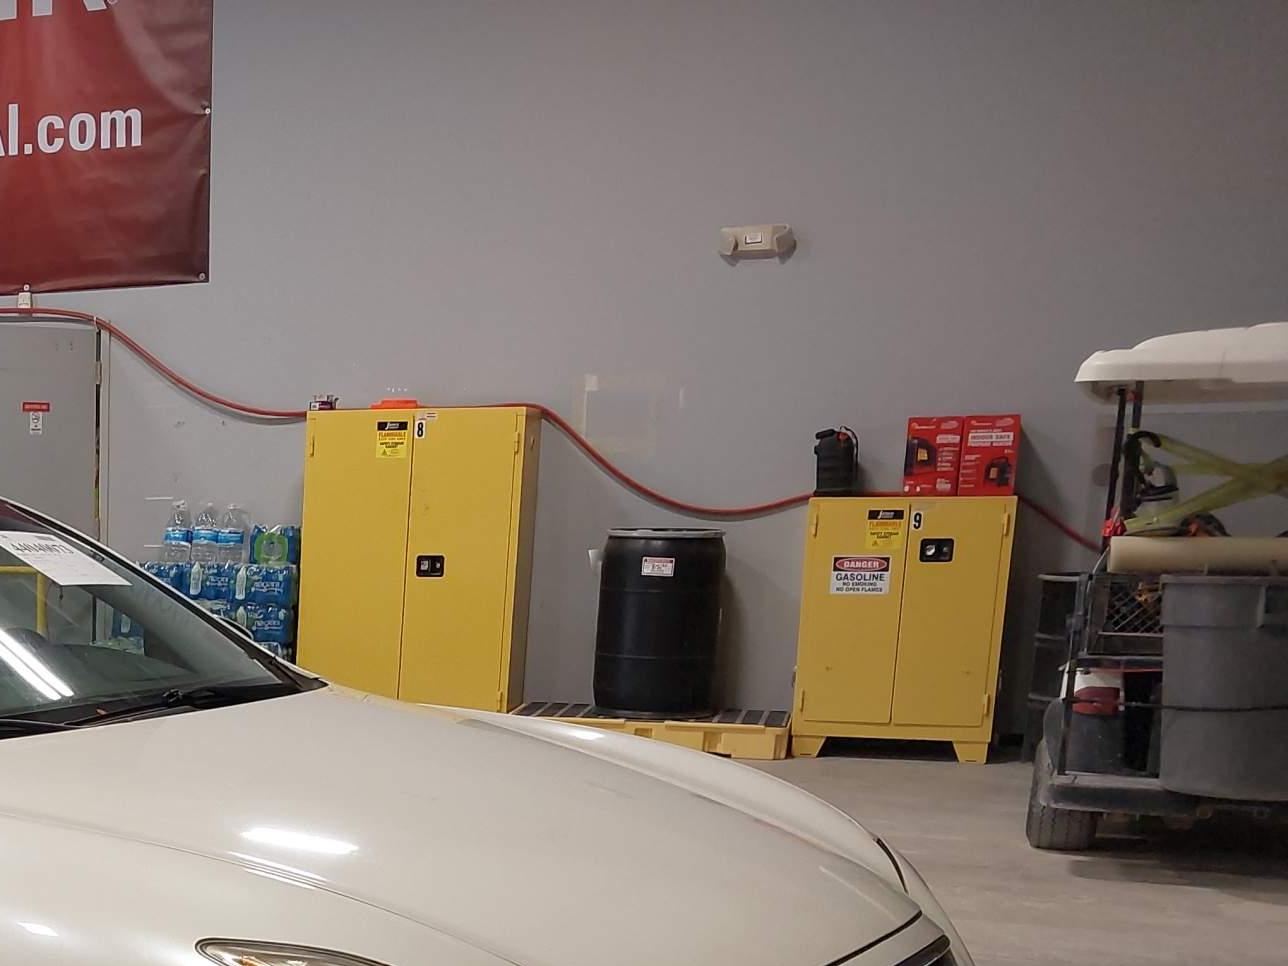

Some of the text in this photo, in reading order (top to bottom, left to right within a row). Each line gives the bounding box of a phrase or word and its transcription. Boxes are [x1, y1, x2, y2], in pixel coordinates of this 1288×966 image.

[416, 421, 424, 438] 8
[913, 512, 922, 529] 9
[843, 560, 880, 569] DANGER
[835, 573, 885, 582] GASOLINE
